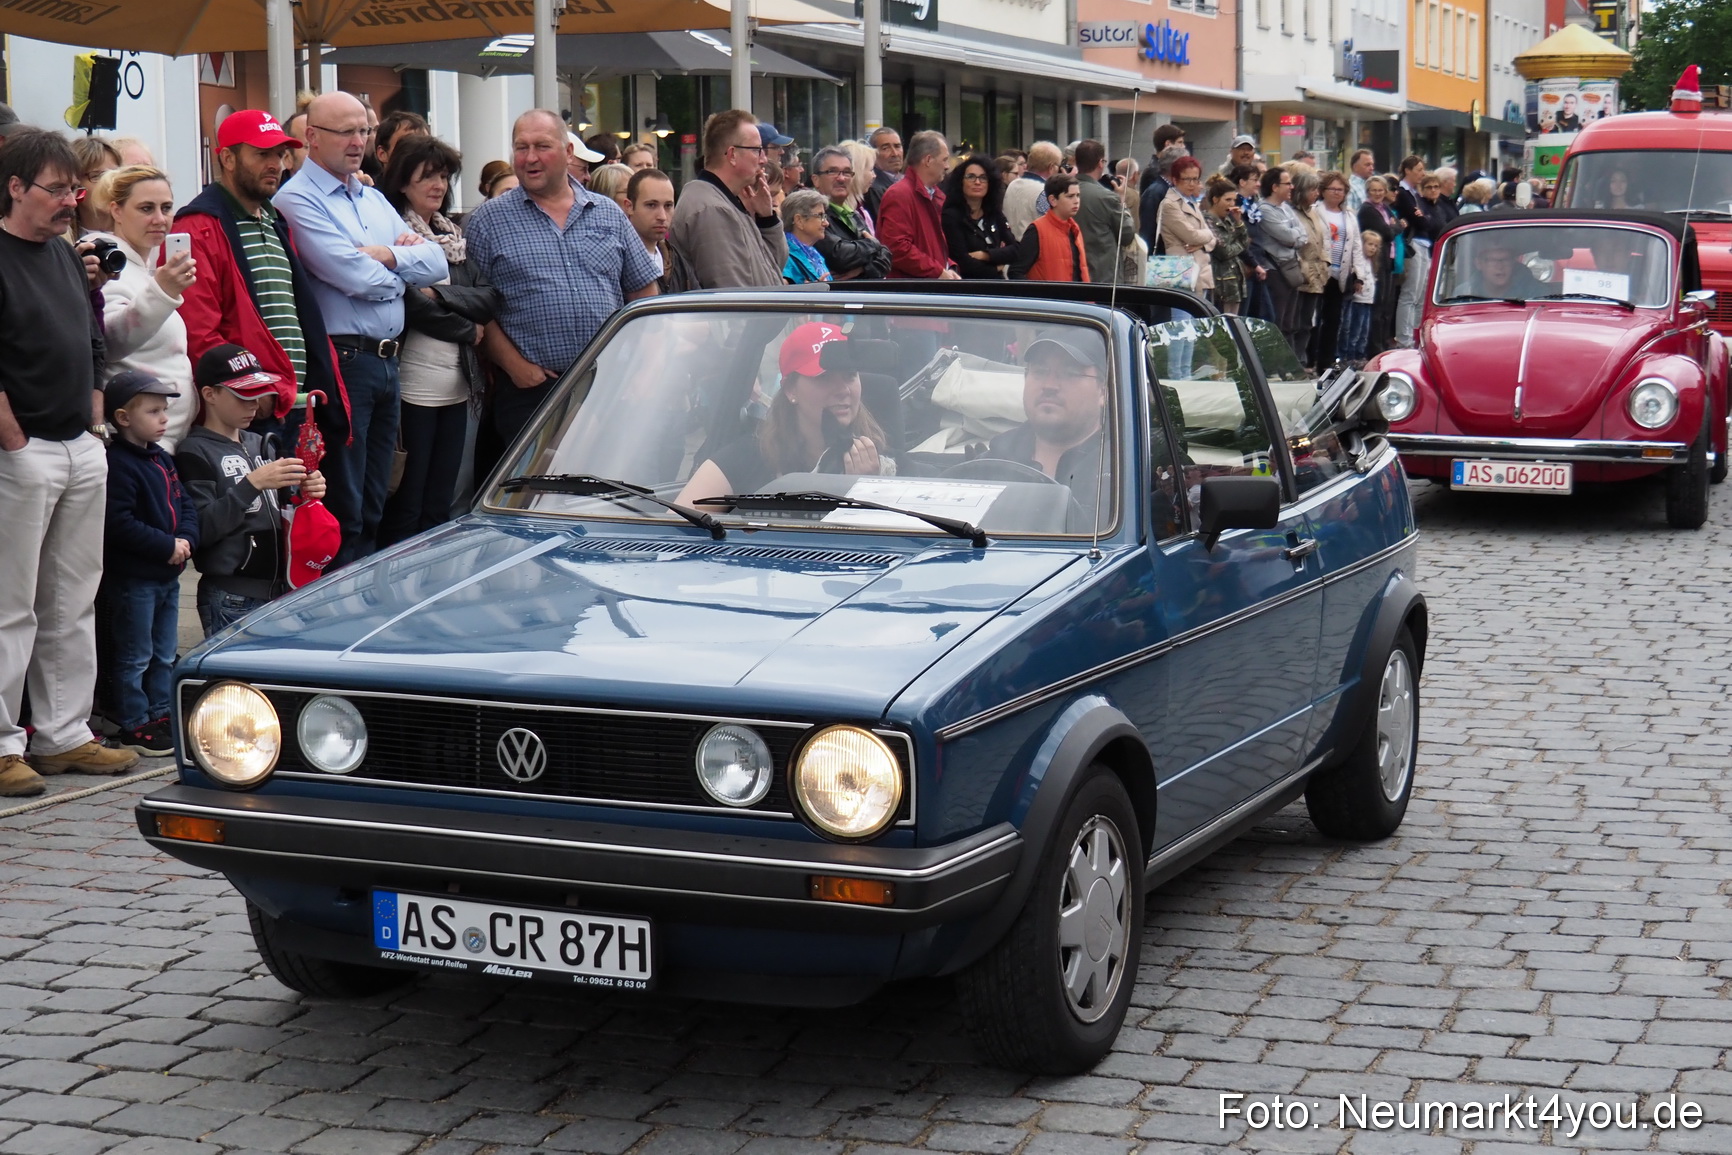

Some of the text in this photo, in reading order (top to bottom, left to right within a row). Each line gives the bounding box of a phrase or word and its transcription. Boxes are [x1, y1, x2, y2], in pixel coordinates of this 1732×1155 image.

[1080, 25, 1134, 43] sutor.
[1145, 19, 1190, 66] sutor.
[1598, 279, 1612, 289] 98
[228, 354, 250, 373] NEW
[1468, 464, 1566, 487] AS 06200
[382, 926, 392, 940] D
[402, 901, 648, 974] AS CR 87H
[381, 951, 468, 969] KFZ-Werkstatt und Reifen
[589, 977, 613, 986] 09621
[617, 979, 623, 987] 8
[624, 980, 635, 988] 63
[635, 981, 647, 989] 04
